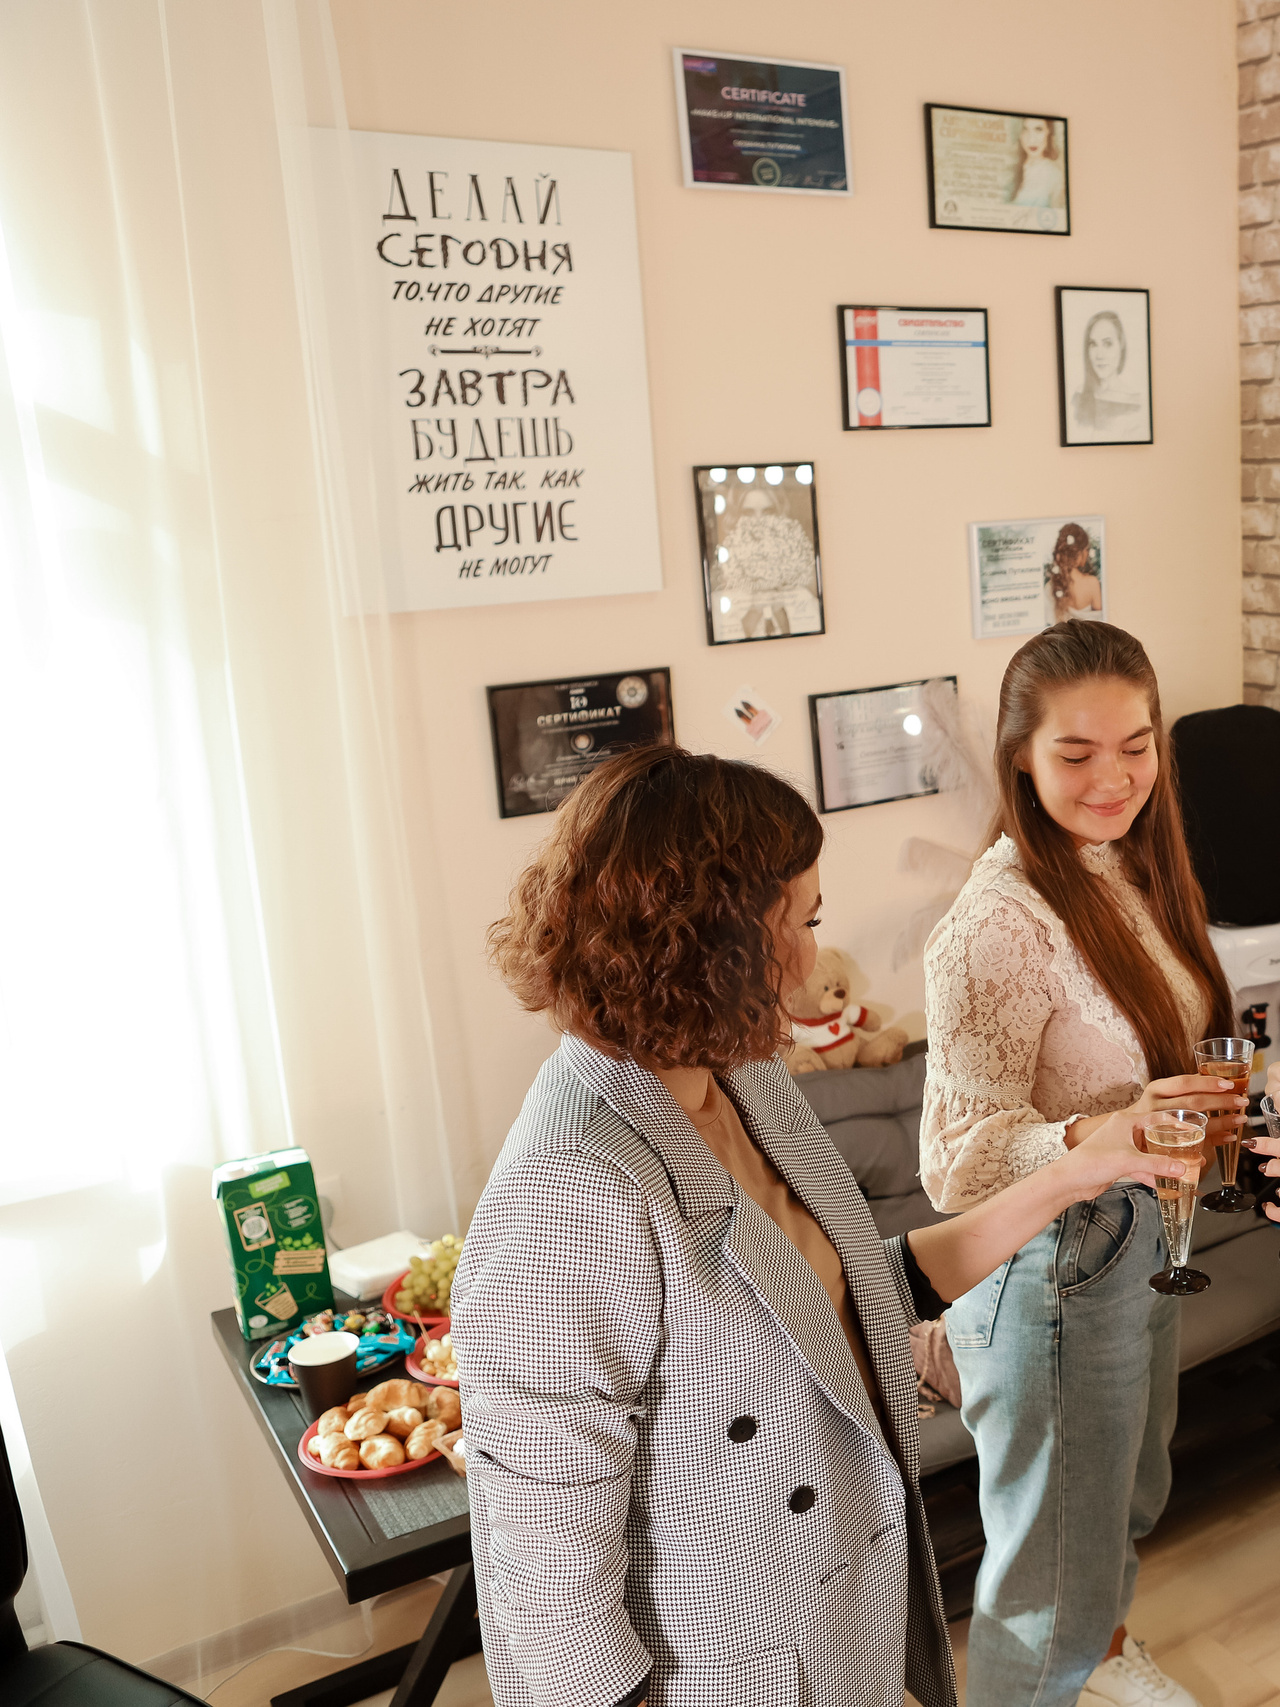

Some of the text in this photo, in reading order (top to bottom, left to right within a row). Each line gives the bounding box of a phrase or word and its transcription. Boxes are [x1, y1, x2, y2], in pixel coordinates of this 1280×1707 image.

[721, 86, 807, 107] CERTIFICATE
[382, 168, 562, 226] ДЕЛАЙ
[376, 233, 574, 275] СЕГОДНЯ
[476, 284, 565, 305] ДРУГИЕ
[424, 317, 541, 338] НЕ ХОТЯТ
[398, 369, 576, 408] ЗАВТРА
[411, 417, 574, 467] БУДЕШЬ
[408, 472, 475, 493] ЖИТЬ
[540, 469, 585, 489] КАК
[435, 500, 578, 553] ДРУГИЕ
[458, 554, 552, 578] НЕ МОГУТ
[536, 705, 622, 727] СЕРТИФИКАТ
